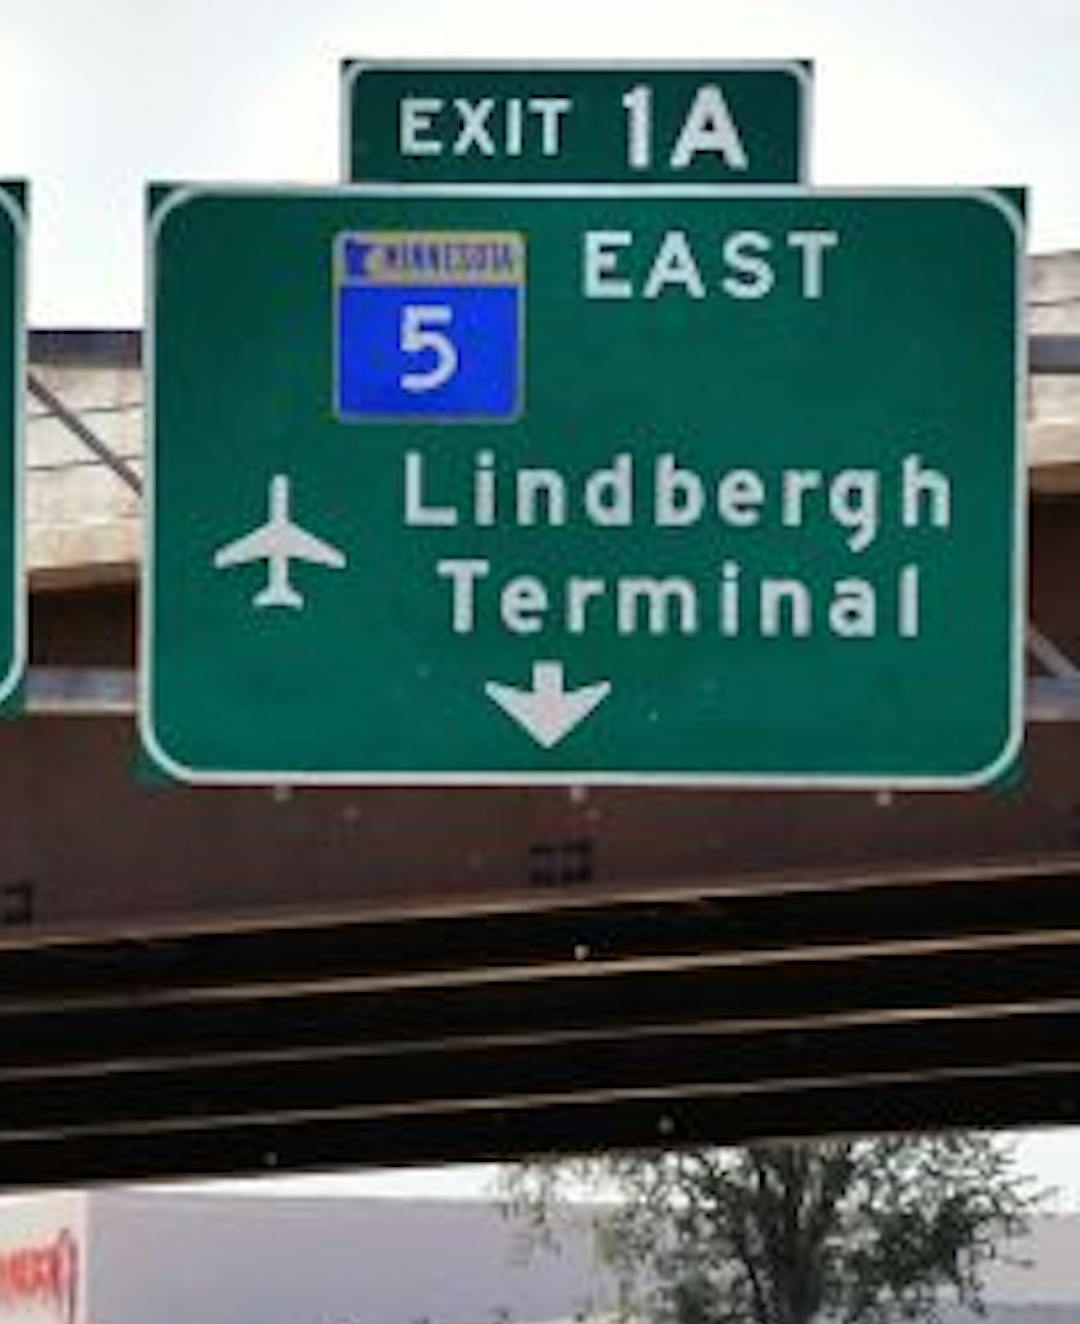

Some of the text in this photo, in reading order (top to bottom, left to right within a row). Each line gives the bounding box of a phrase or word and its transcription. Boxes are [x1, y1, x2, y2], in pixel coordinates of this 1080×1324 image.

[399, 86, 747, 168] EXIT 1A
[583, 231, 838, 298] EAST
[400, 304, 459, 392] 5
[404, 453, 951, 551] Lindbergh
[437, 560, 919, 638] Terminal
